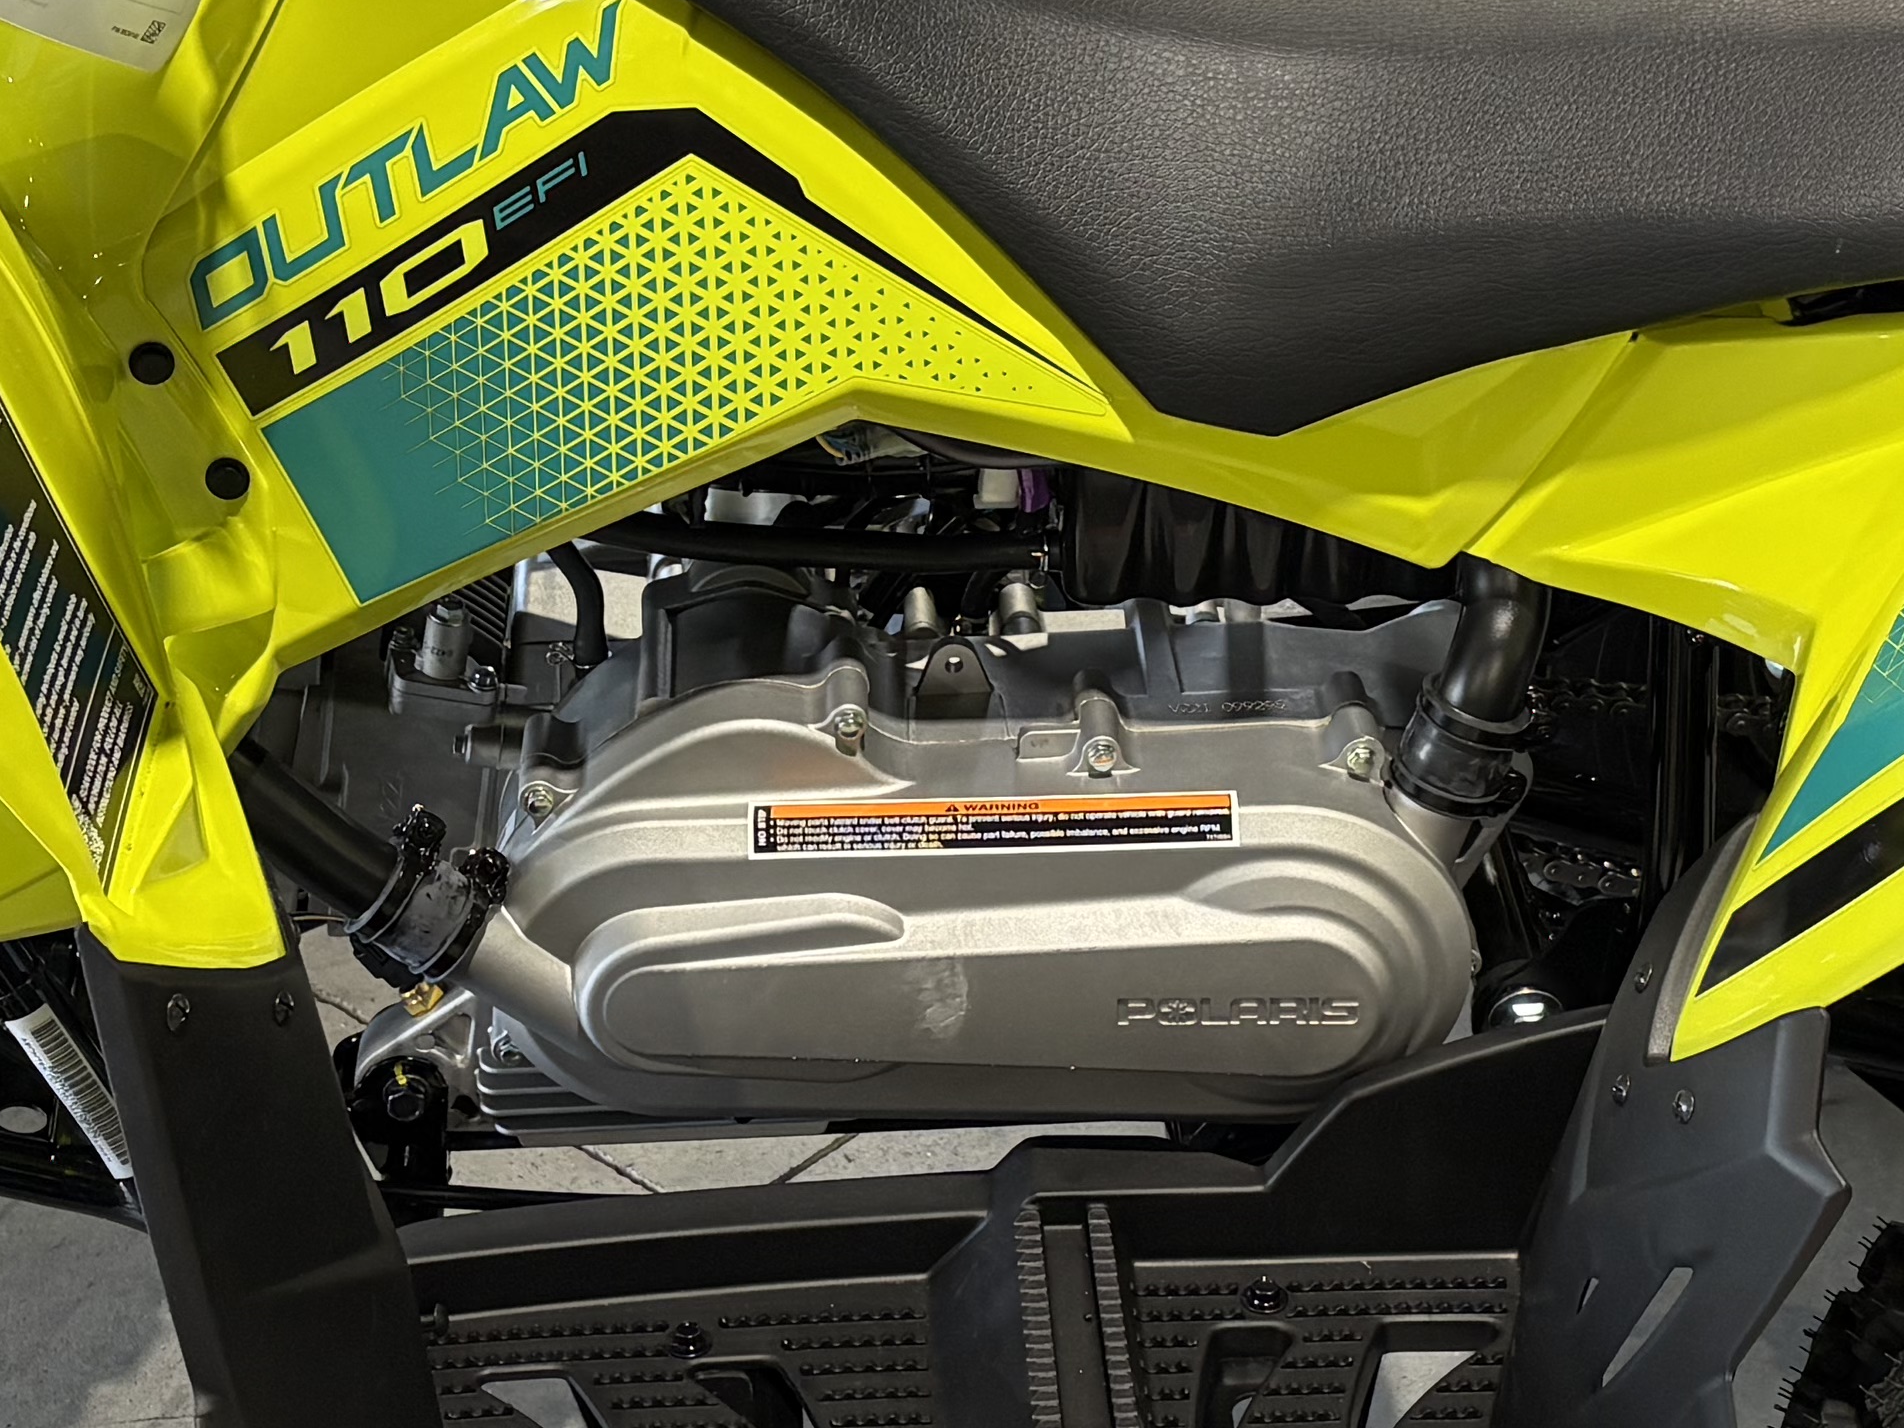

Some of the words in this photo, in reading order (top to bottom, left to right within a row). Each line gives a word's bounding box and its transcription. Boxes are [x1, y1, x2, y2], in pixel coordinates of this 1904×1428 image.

[269, 218, 489, 375] 110
[493, 151, 588, 231] EFI
[963, 802, 1040, 813] WARNING
[957, 815, 968, 823] To
[757, 830, 767, 847] NO
[1117, 997, 1359, 1025] POLARIS
